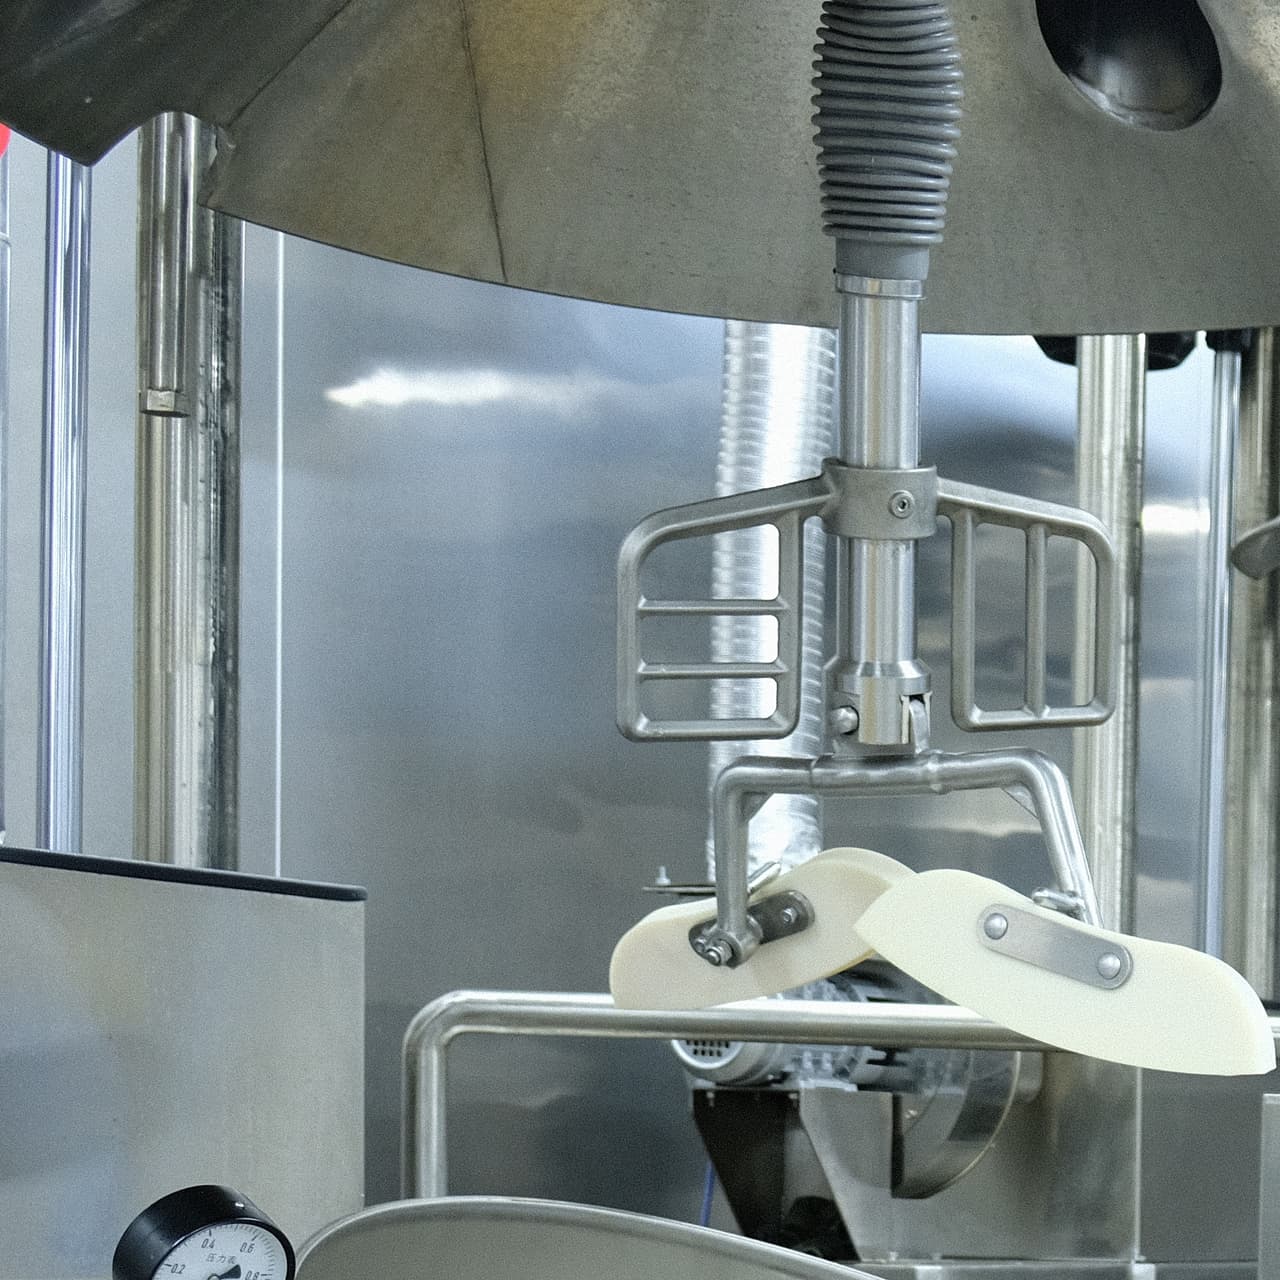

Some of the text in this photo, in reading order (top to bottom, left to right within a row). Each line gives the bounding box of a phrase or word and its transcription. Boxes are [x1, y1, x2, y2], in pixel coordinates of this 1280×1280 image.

[201, 1238, 216, 1249] 0.4
[239, 1242, 255, 1254] 0.6
[170, 1263, 186, 1275] 0.2
[244, 1270, 260, 1280] 0.8
